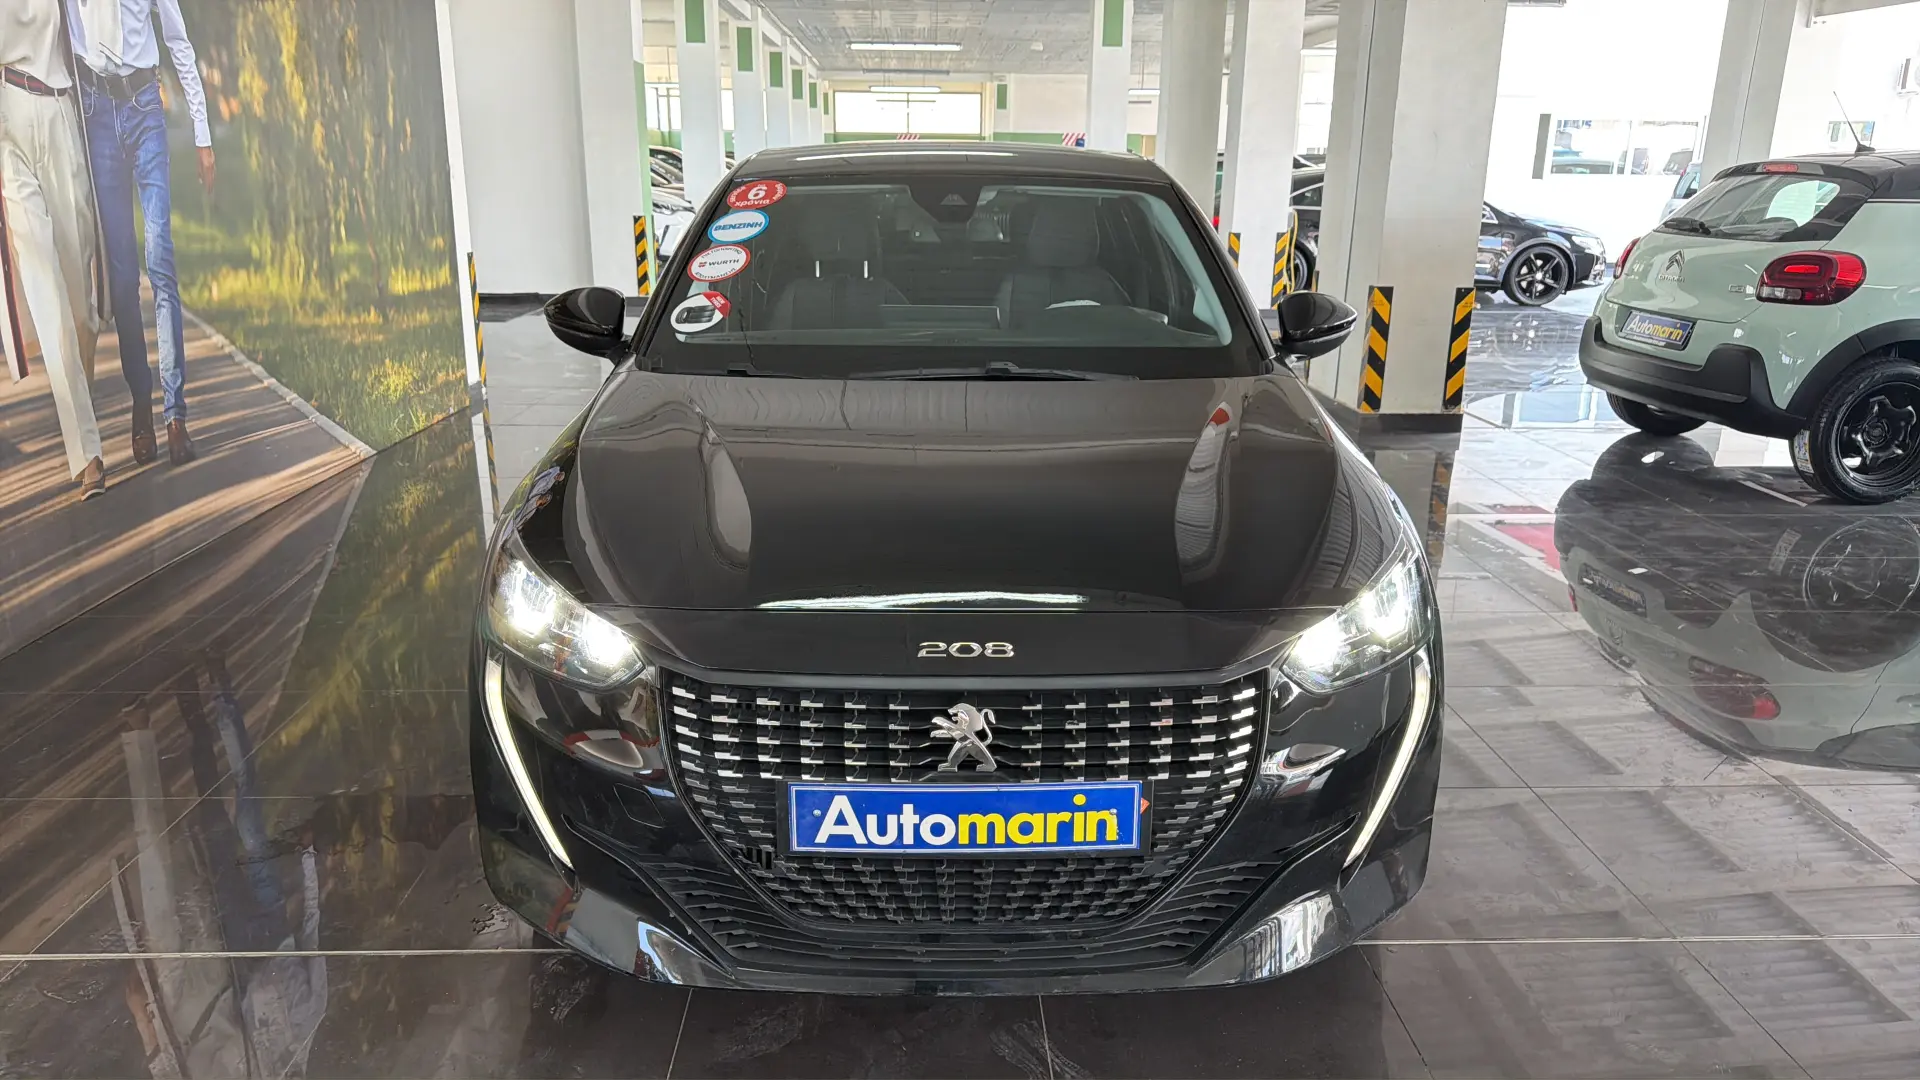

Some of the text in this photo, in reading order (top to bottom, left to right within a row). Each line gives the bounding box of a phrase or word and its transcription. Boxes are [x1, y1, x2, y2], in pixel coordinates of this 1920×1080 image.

[747, 186, 768, 200] 6
[1626, 315, 1684, 340] Automarin
[917, 641, 1015, 658] 208
[814, 794, 1119, 845] Automarin
